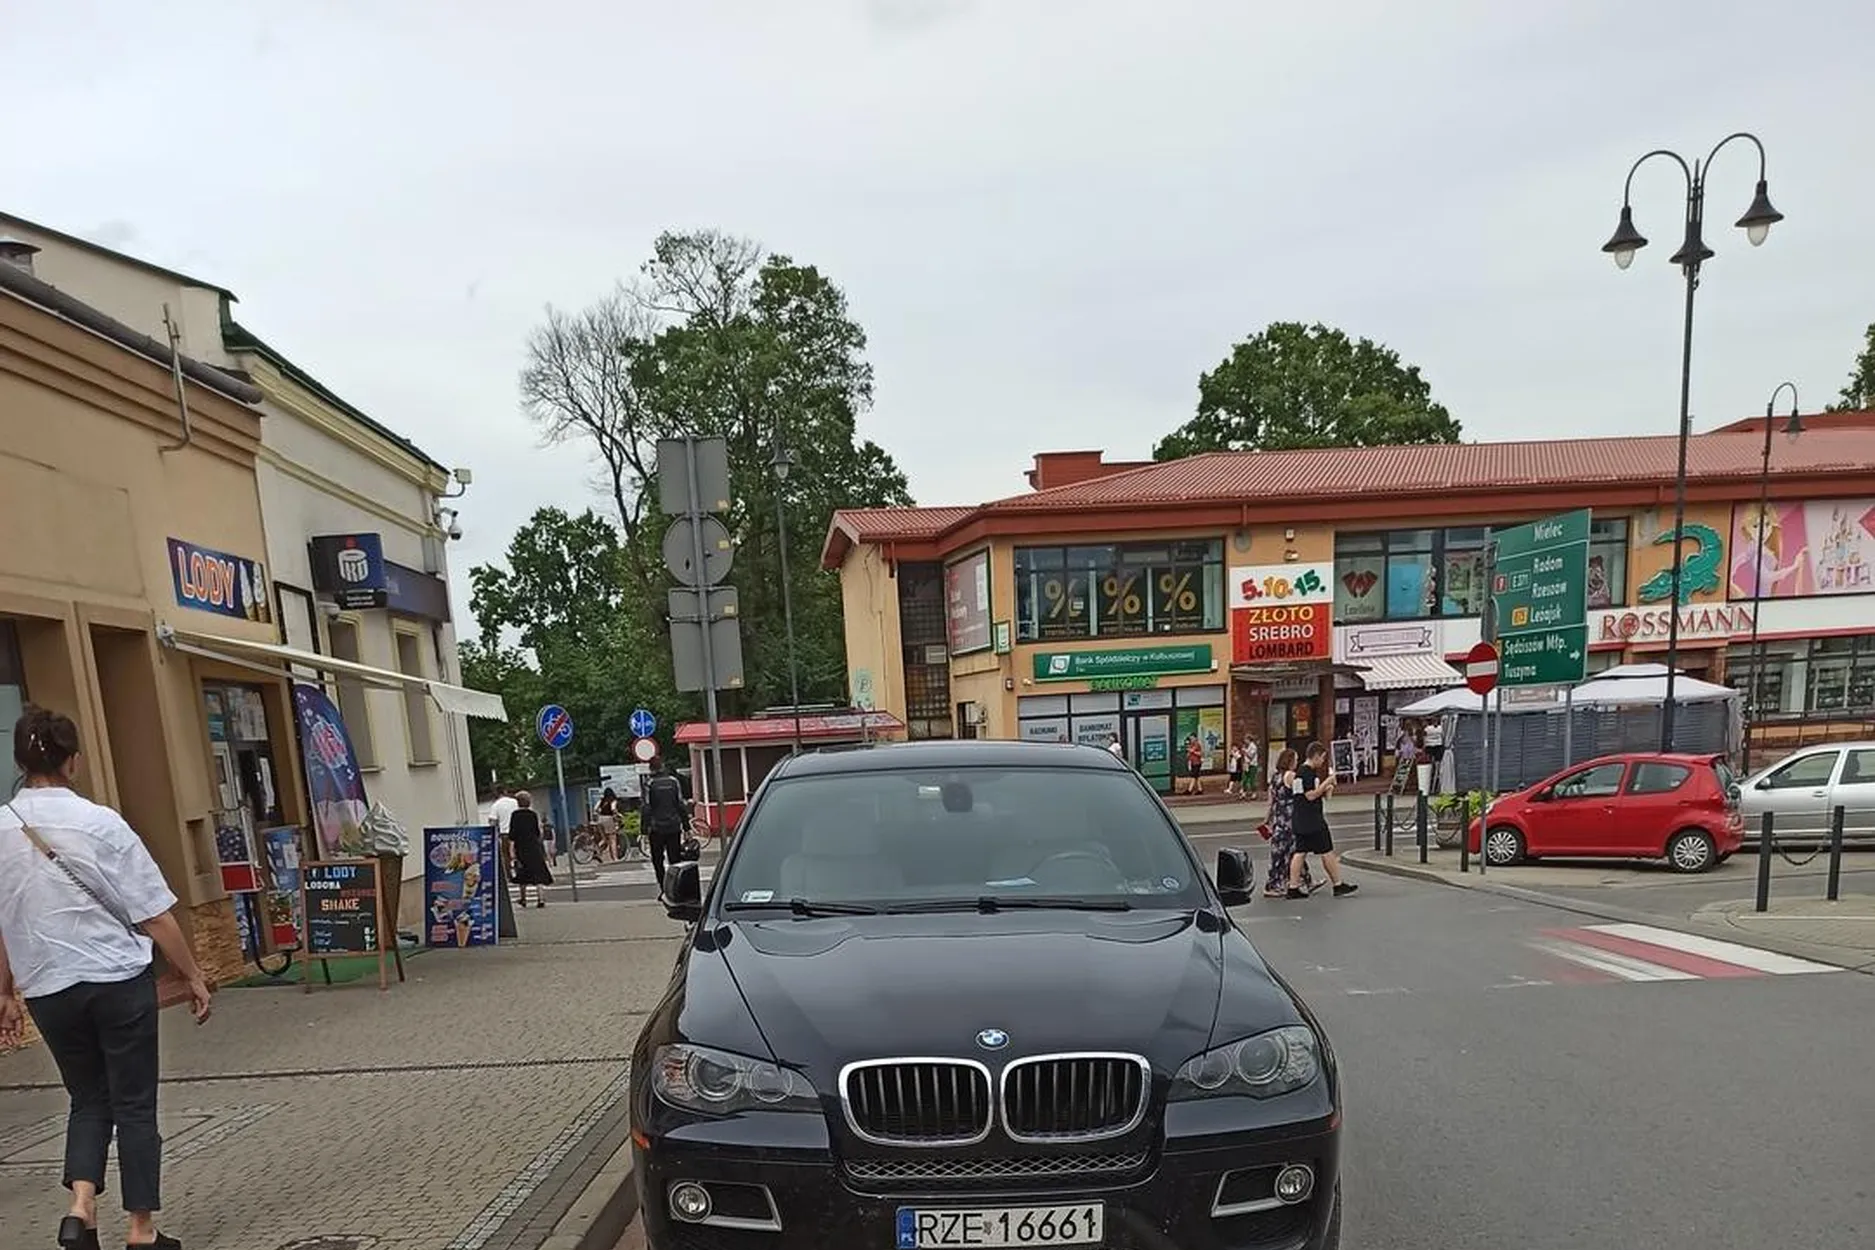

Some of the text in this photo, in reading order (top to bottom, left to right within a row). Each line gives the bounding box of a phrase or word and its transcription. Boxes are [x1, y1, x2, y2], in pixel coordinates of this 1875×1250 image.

[1533, 522, 1563, 542] Mielec
[1532, 556, 1563, 574] Radom
[176, 546, 234, 608] LODY
[1248, 606, 1314, 625] ZŁOTO
[1601, 605, 1756, 641] ROSSMANN
[1248, 624, 1314, 642] SREBRO
[1249, 641, 1314, 660] LOMBARD
[321, 899, 360, 911] SHAKE
[918, 1207, 1096, 1244] RZE 16661
